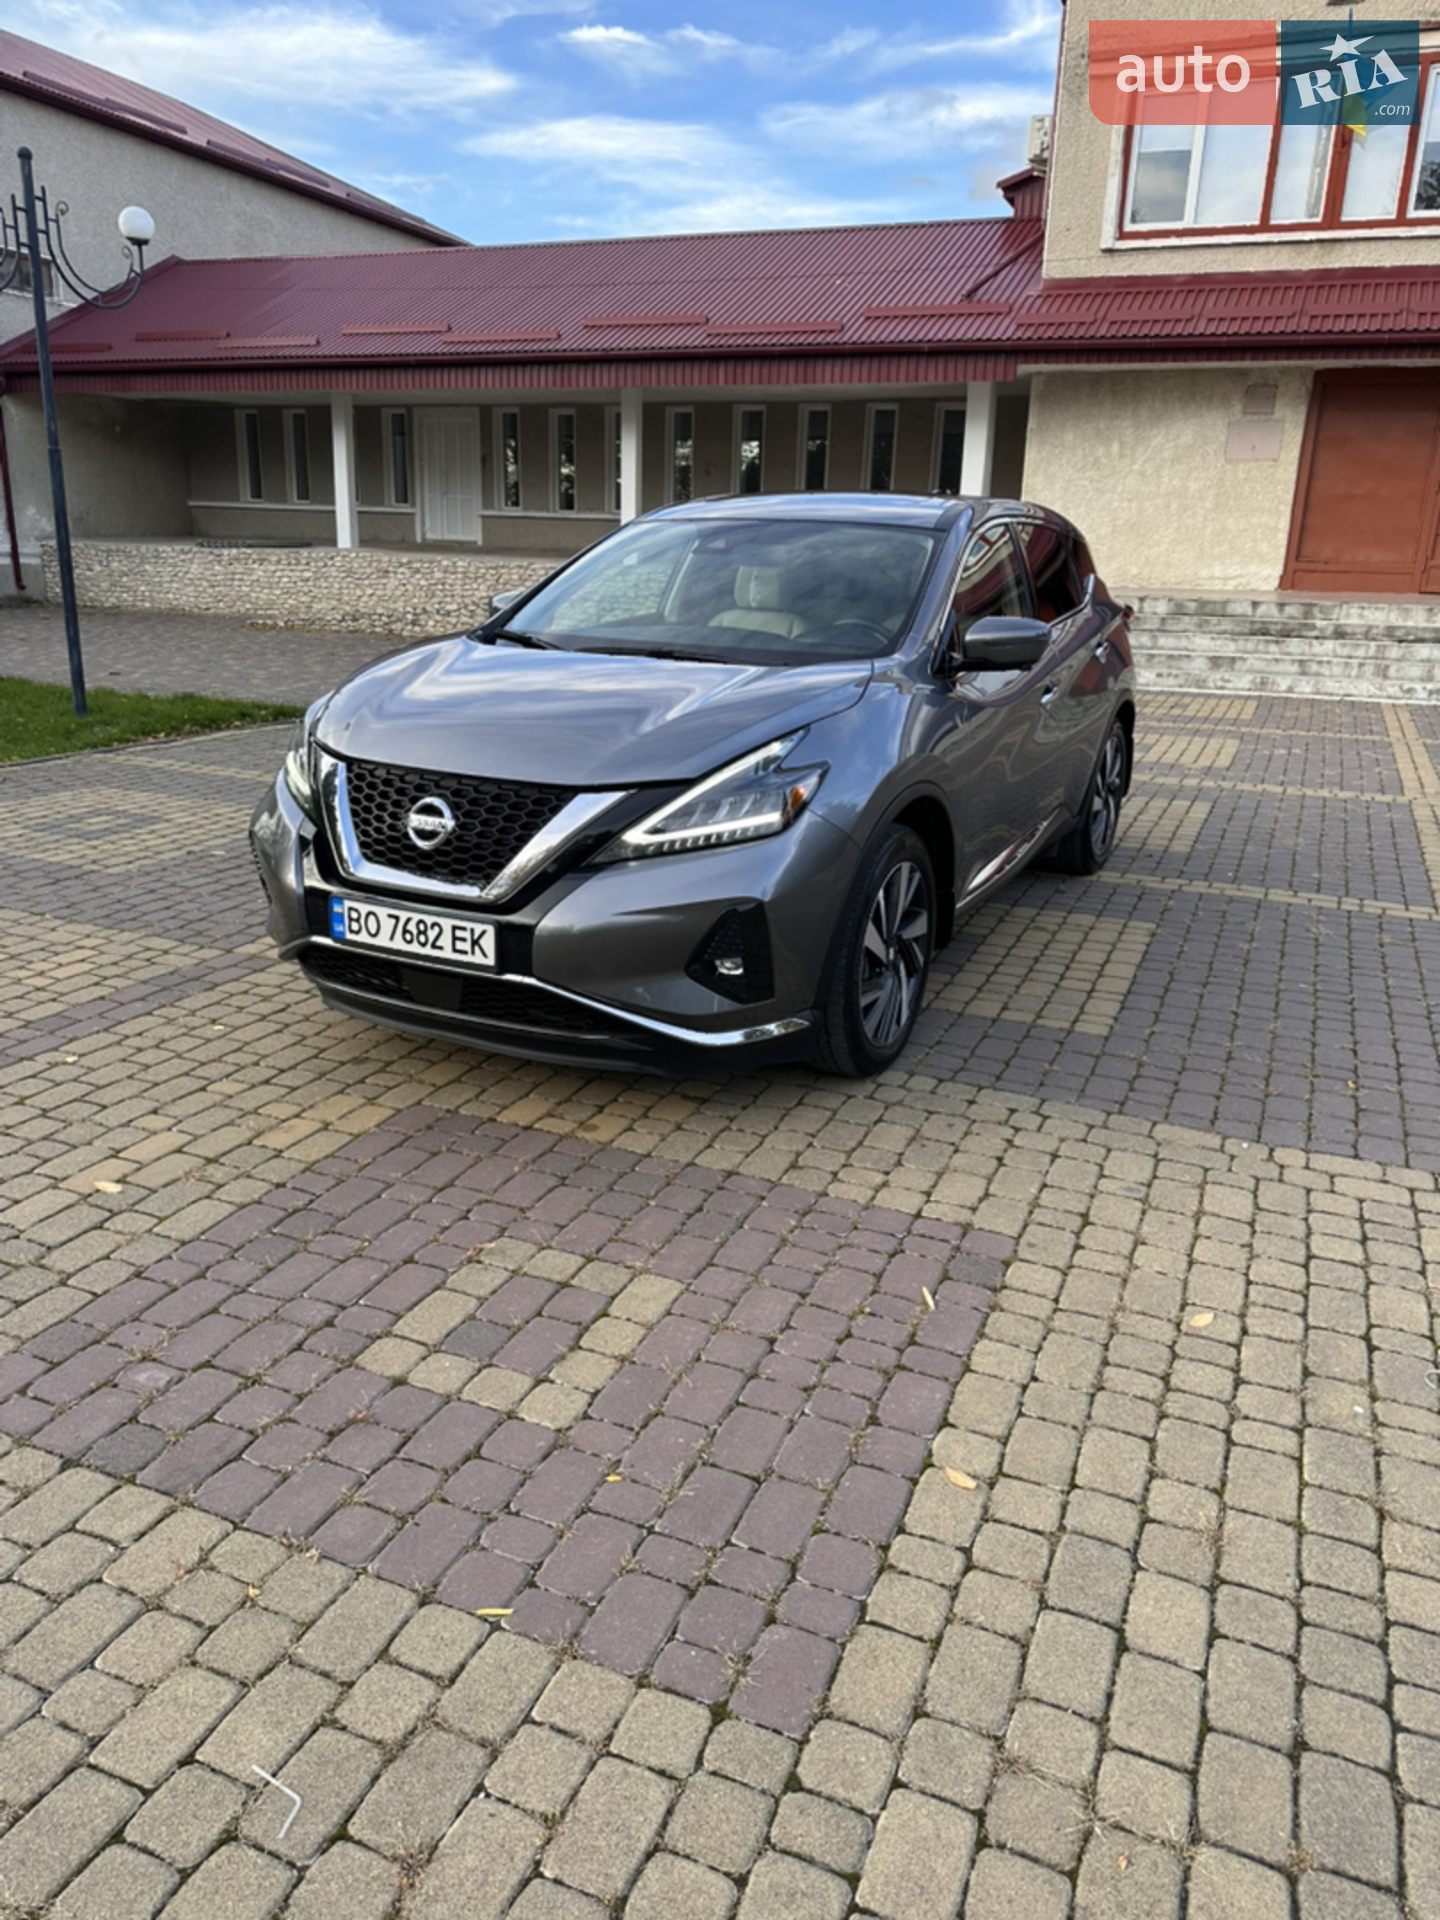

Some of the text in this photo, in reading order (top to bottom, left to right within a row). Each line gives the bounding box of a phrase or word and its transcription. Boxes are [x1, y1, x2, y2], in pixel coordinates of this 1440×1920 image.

[410, 815, 450, 831] SSAN
[347, 906, 489, 959] BO 7682 EK
